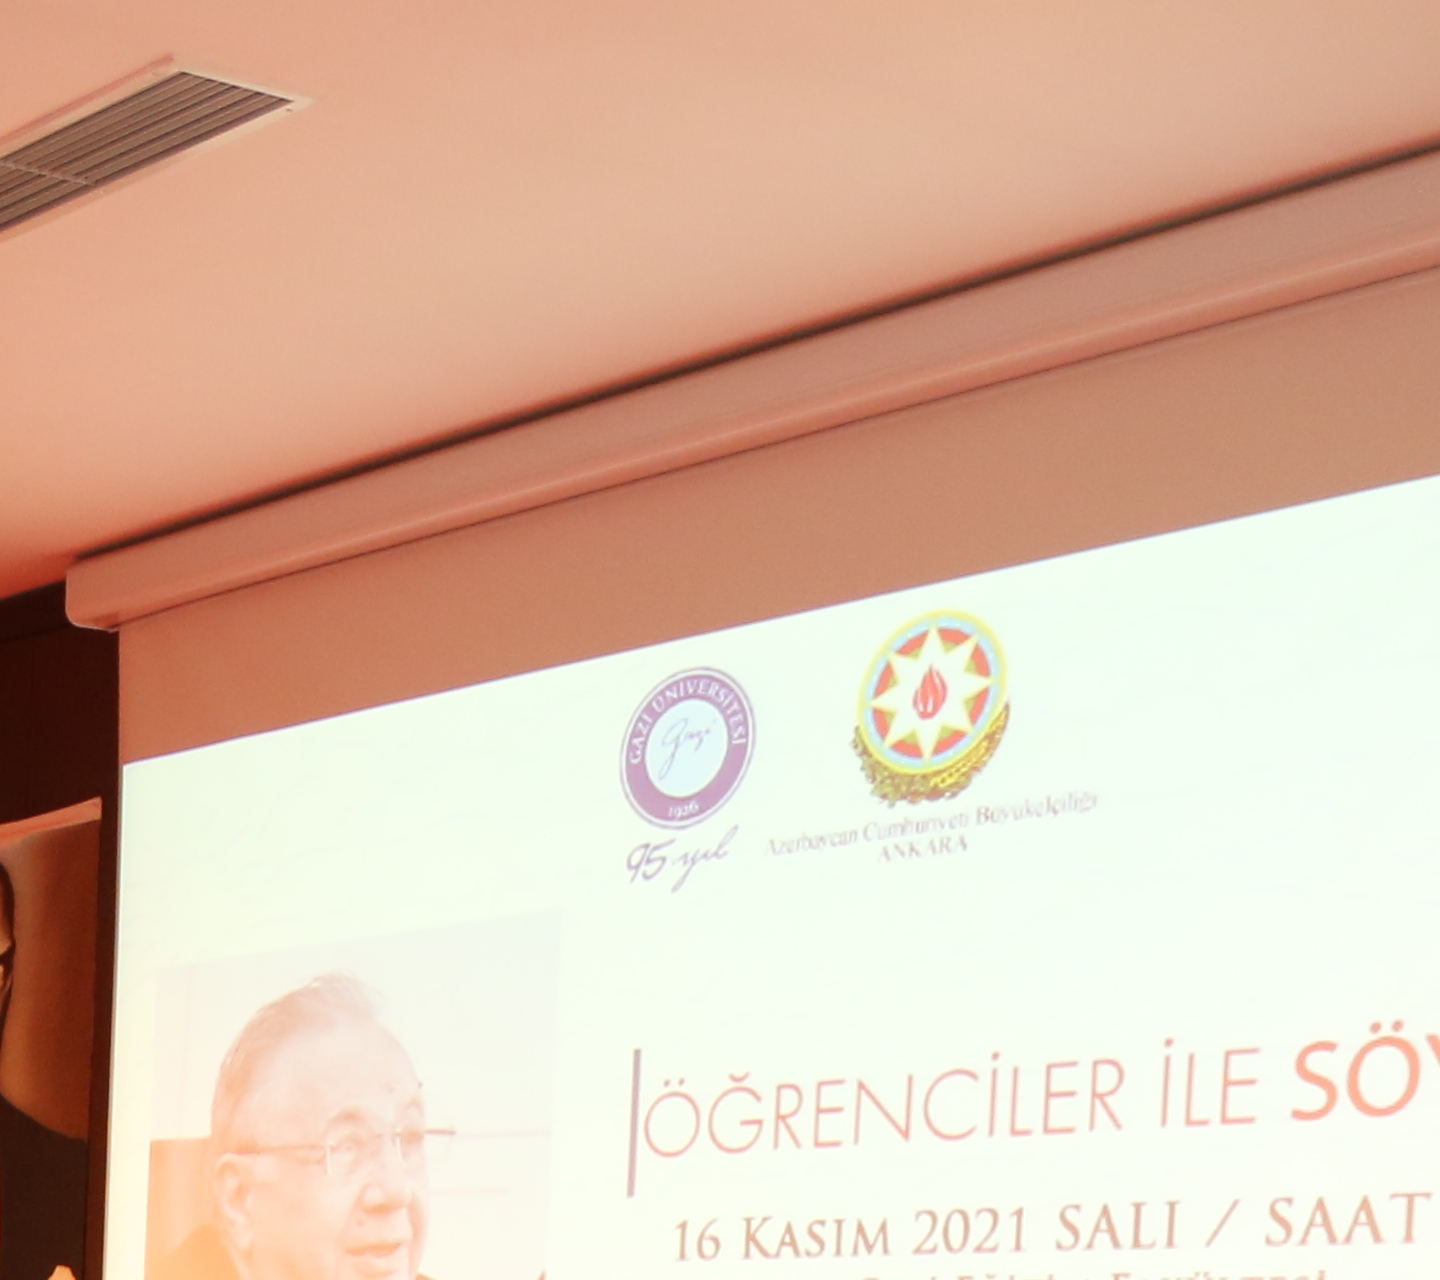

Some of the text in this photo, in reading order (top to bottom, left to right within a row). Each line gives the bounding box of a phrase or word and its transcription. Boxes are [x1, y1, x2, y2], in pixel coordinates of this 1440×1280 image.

[876, 833, 969, 864] ANKARA
[643, 1051, 1126, 1158] ÖĞRENCİLER
[1160, 1036, 1261, 1128] İLE
[674, 1217, 722, 1262] 16
[741, 1215, 892, 1261] KASIM
[912, 1206, 1026, 1256] 2021
[1055, 1200, 1181, 1253] SALI
[1263, 1190, 1433, 1248] SAAT
